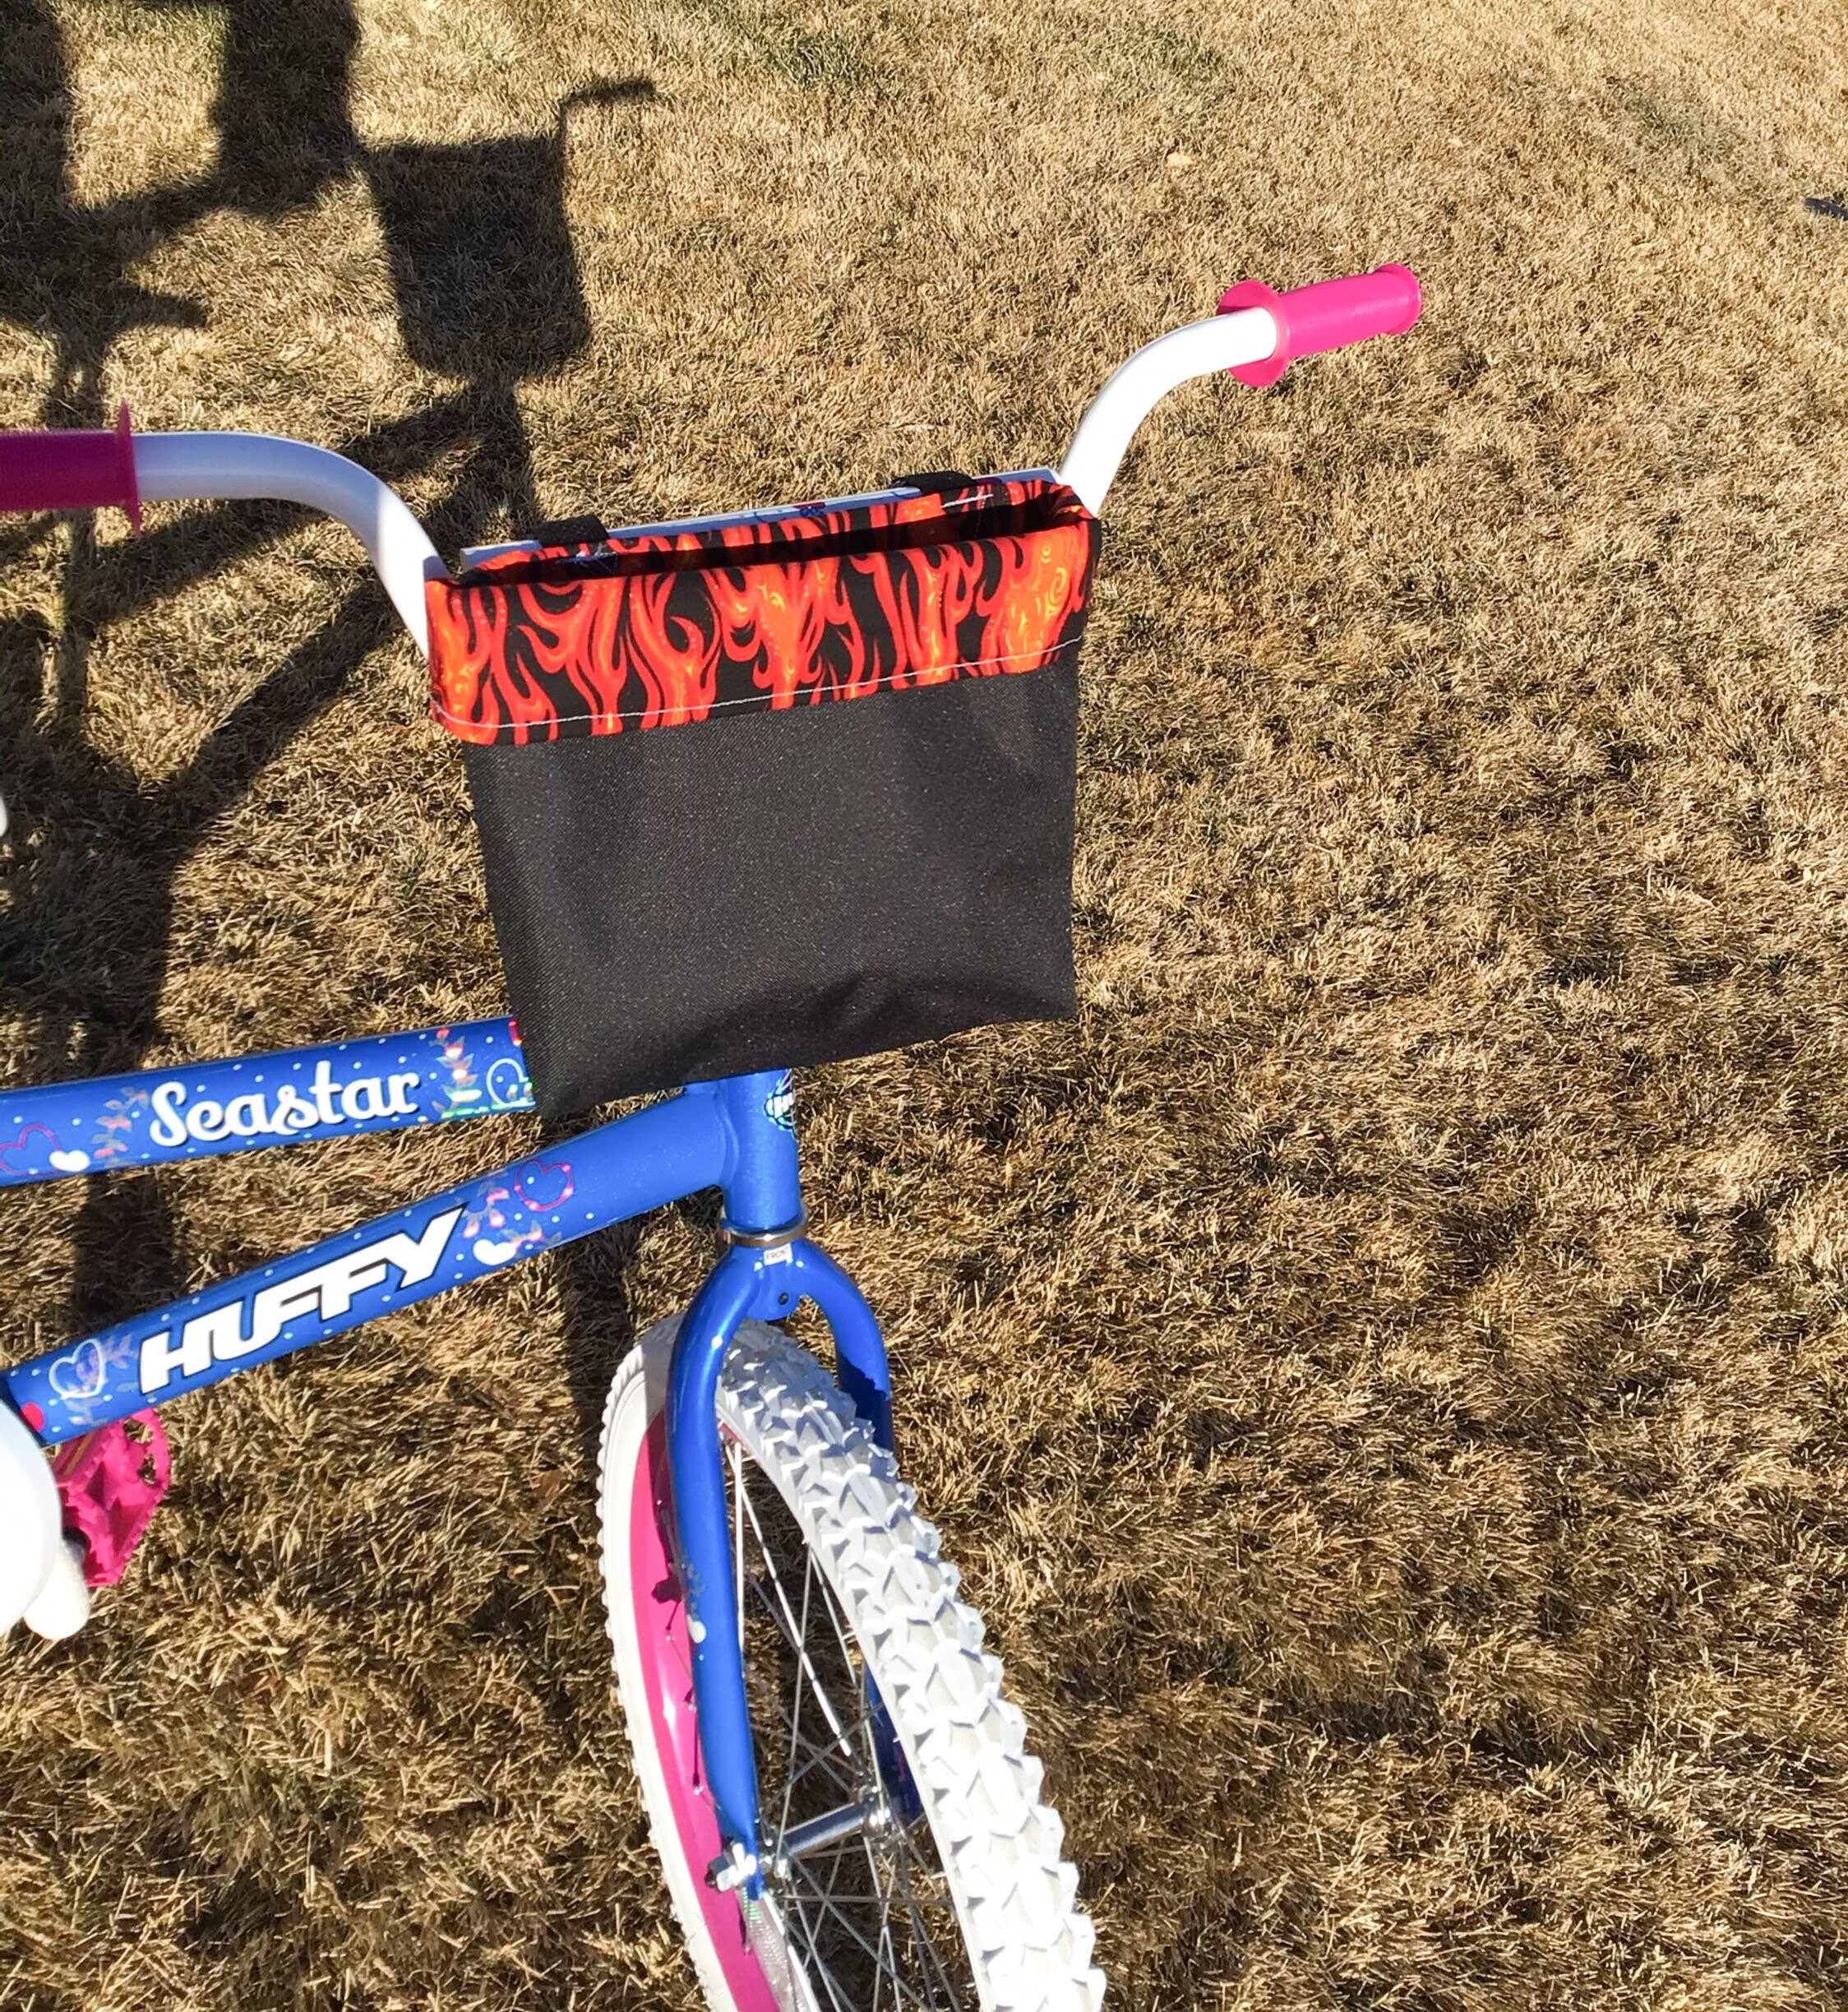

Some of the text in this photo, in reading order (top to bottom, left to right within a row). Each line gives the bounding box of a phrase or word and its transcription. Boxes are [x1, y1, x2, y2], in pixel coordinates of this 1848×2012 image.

[150, 1060, 419, 1147] Seastar
[766, 1245, 789, 1260] FRONT
[139, 1203, 466, 1395] HUFFY
